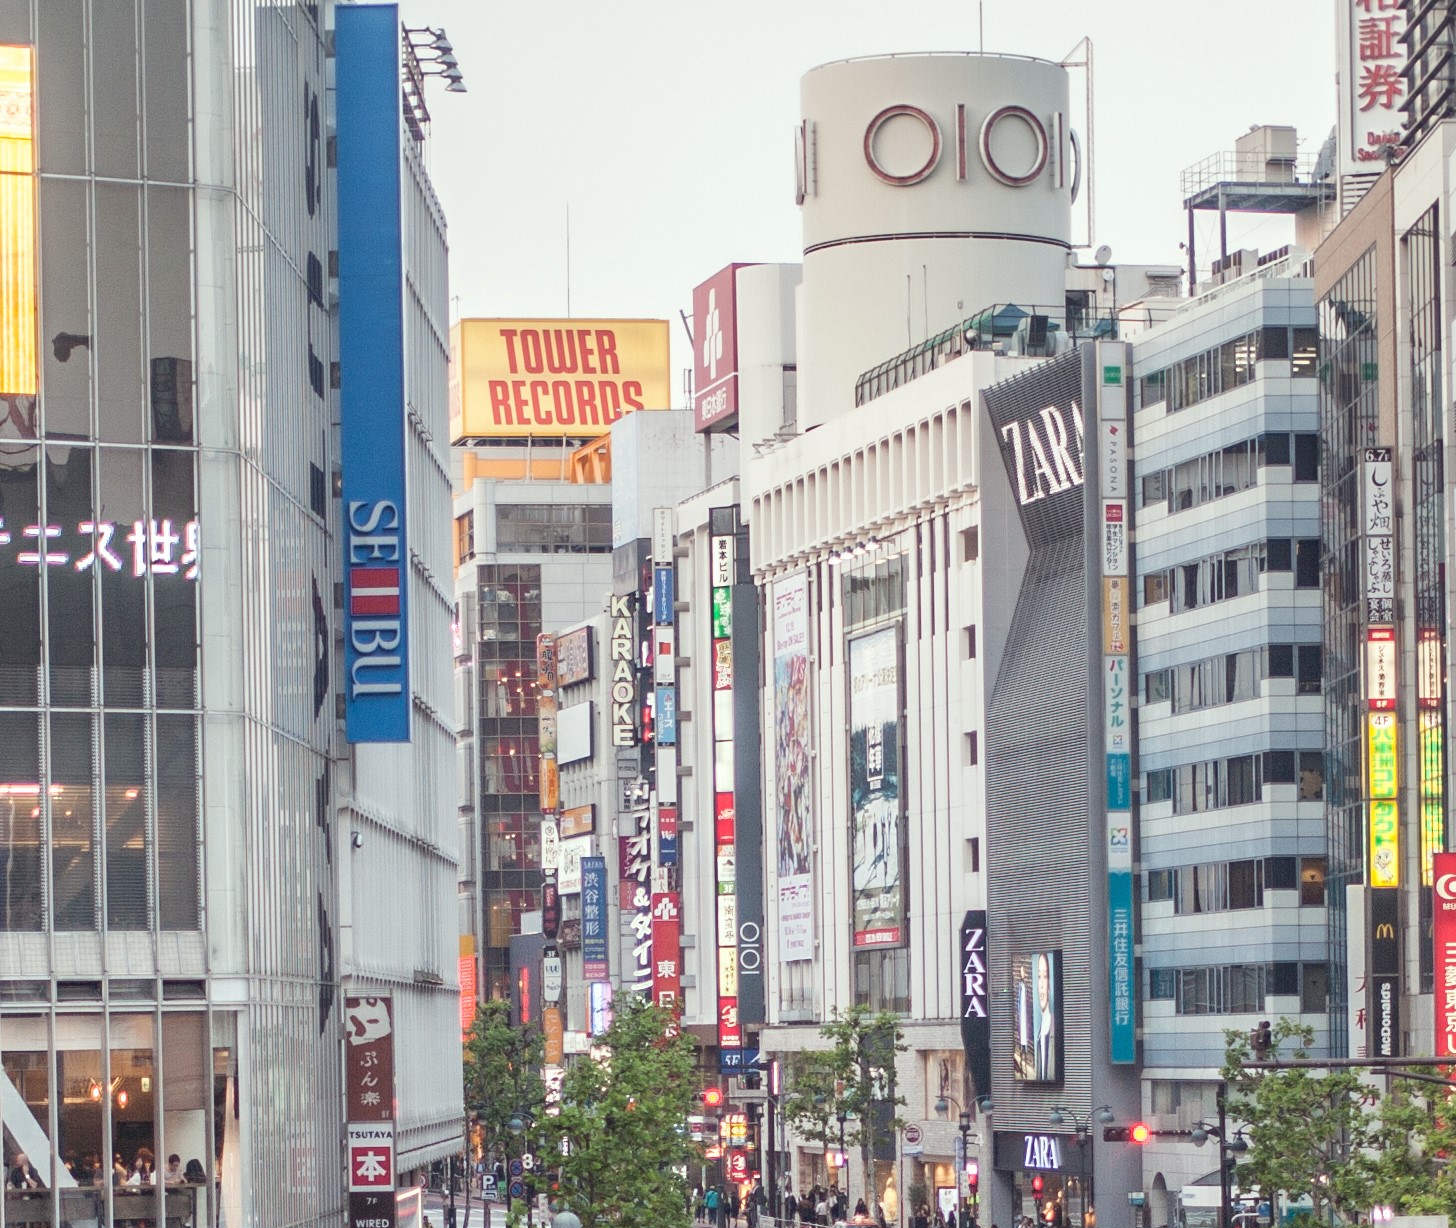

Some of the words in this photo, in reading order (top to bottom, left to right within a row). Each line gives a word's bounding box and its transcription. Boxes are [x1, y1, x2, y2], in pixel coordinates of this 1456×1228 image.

[1356, 0, 1405, 112] 証券
[500, 329, 620, 375] TOWER
[488, 380, 644, 425] RECORDS
[1109, 441, 1119, 493] PASONA
[1370, 466, 1391, 531] しぶや畑
[718, 539, 728, 584] 岩本ビル
[349, 500, 402, 699] SEIBU
[611, 594, 635, 747] KARAOKE
[1109, 659, 1124, 727] パーソナル
[1374, 715, 1389, 727] 4F
[584, 872, 600, 936] 渋谷整形
[964, 928, 987, 1018] ZARA
[1380, 981, 1392, 1056] McDonald's
[348, 1130, 393, 1139] TSUTAYA
[1024, 1135, 1059, 1169] ZARA
[356, 1150, 387, 1182] 本
[482, 1173, 494, 1190] P
[355, 1218, 390, 1228] WIRED
